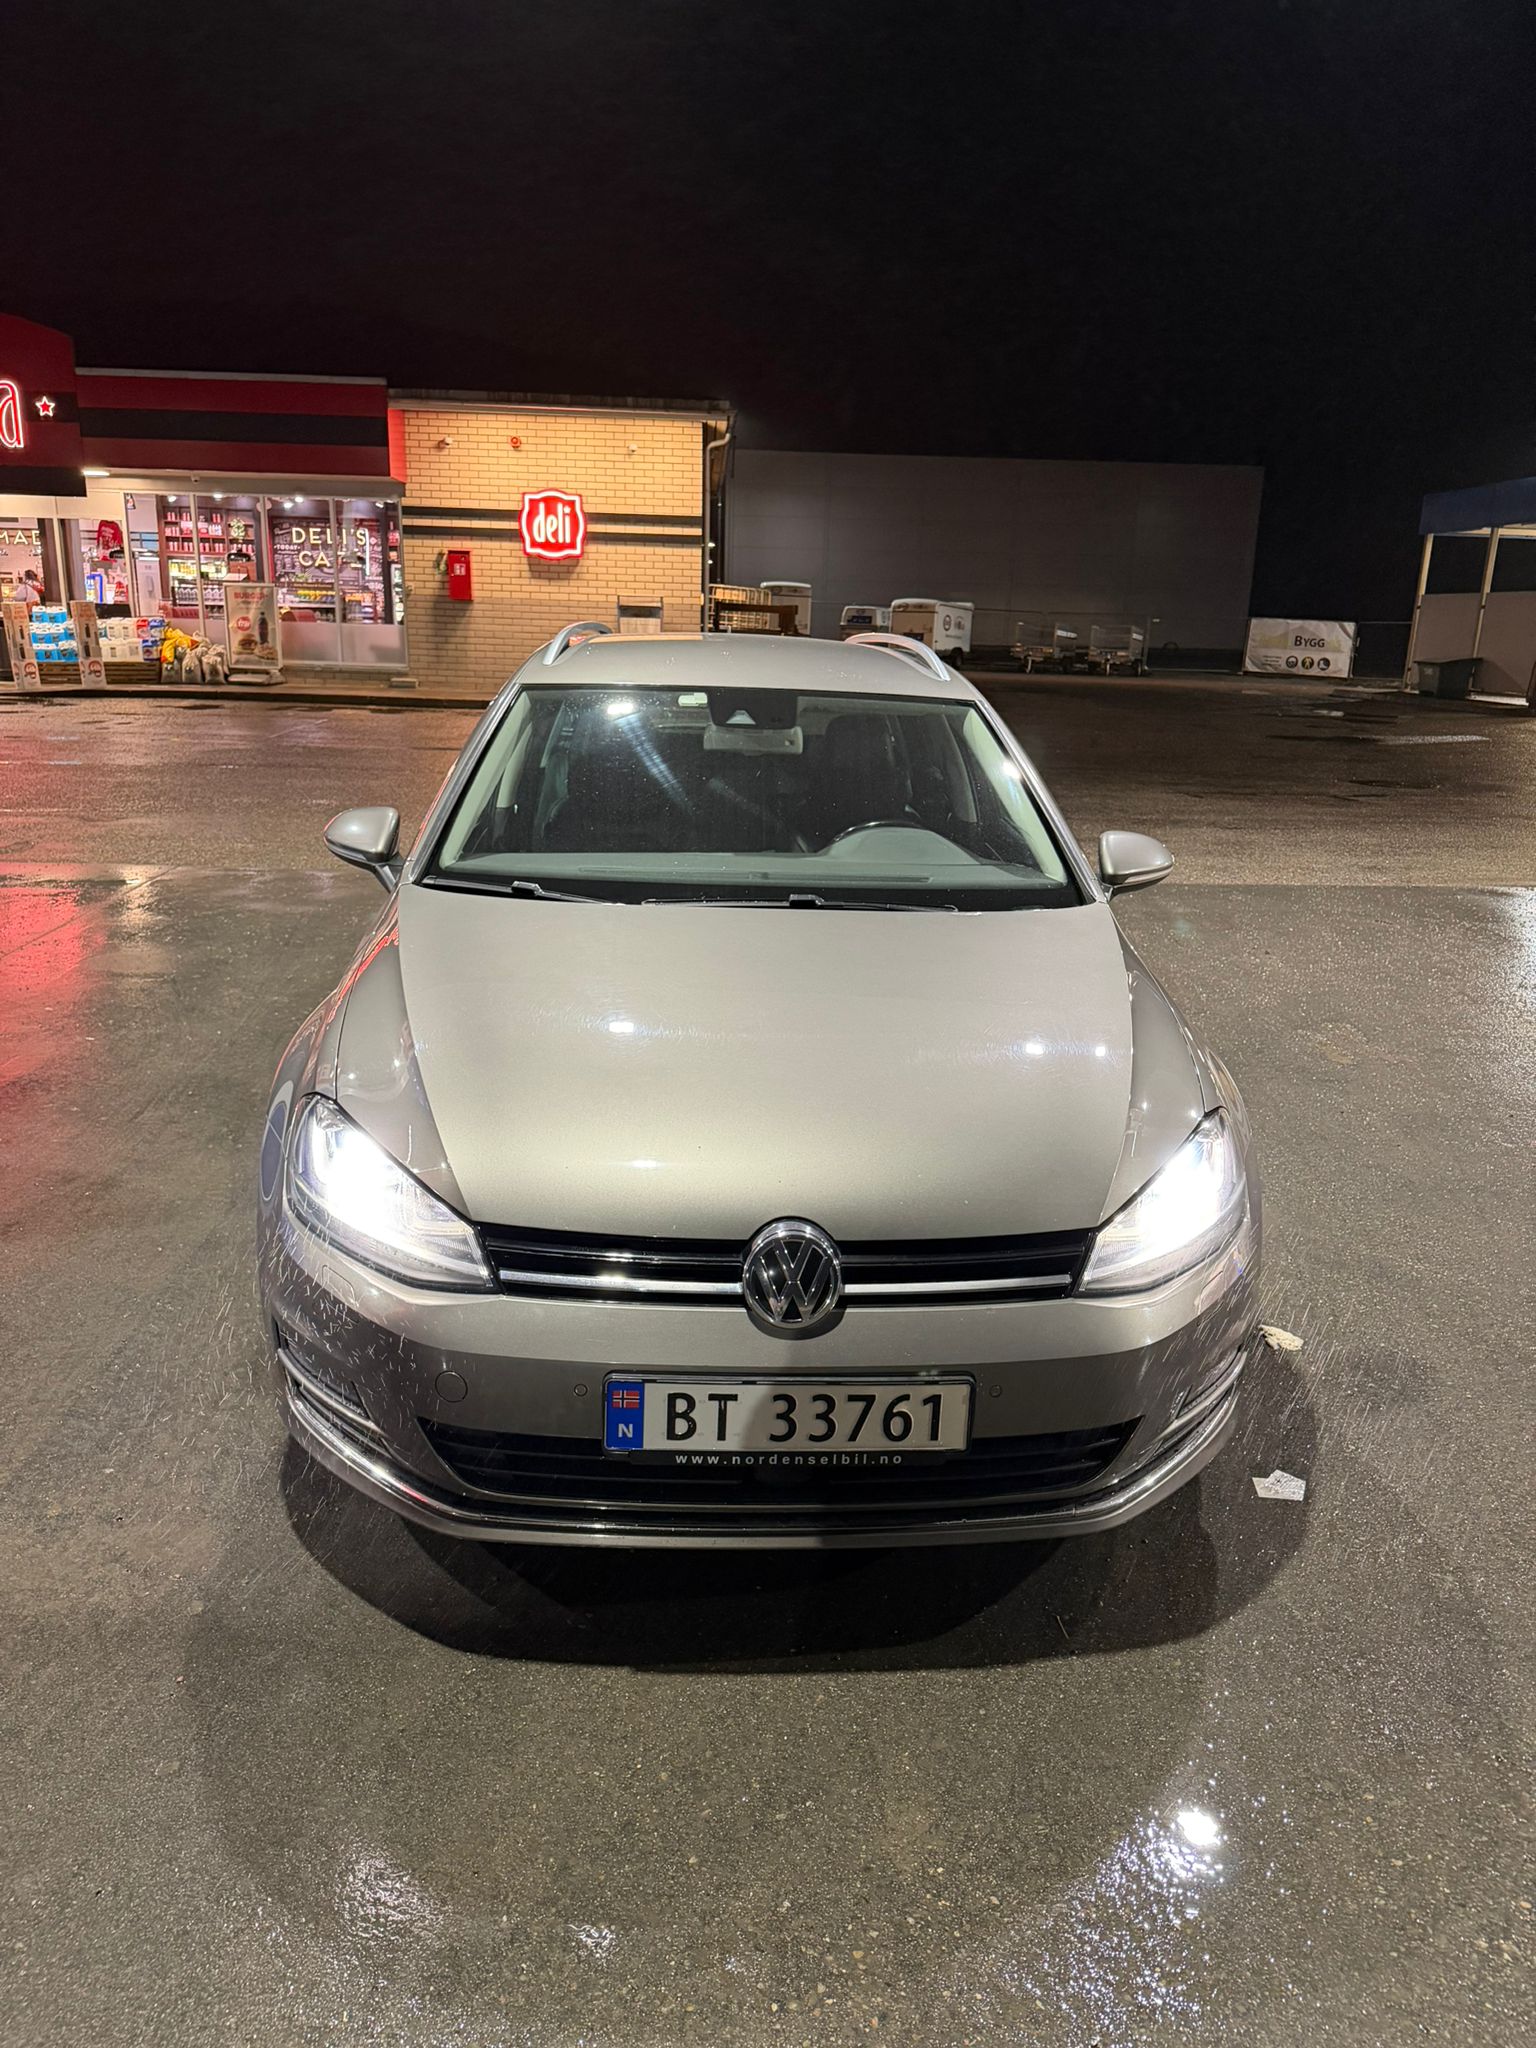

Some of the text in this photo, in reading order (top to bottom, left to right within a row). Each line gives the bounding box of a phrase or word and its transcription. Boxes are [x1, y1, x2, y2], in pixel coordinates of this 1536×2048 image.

[532, 501, 571, 544] deli
[291, 527, 367, 545] DELI'S
[1294, 635, 1326, 648] BYGG
[666, 1392, 944, 1442] BT 33761
[618, 1423, 633, 1438] N
[675, 1453, 903, 1465] www.nordenselbil.no
